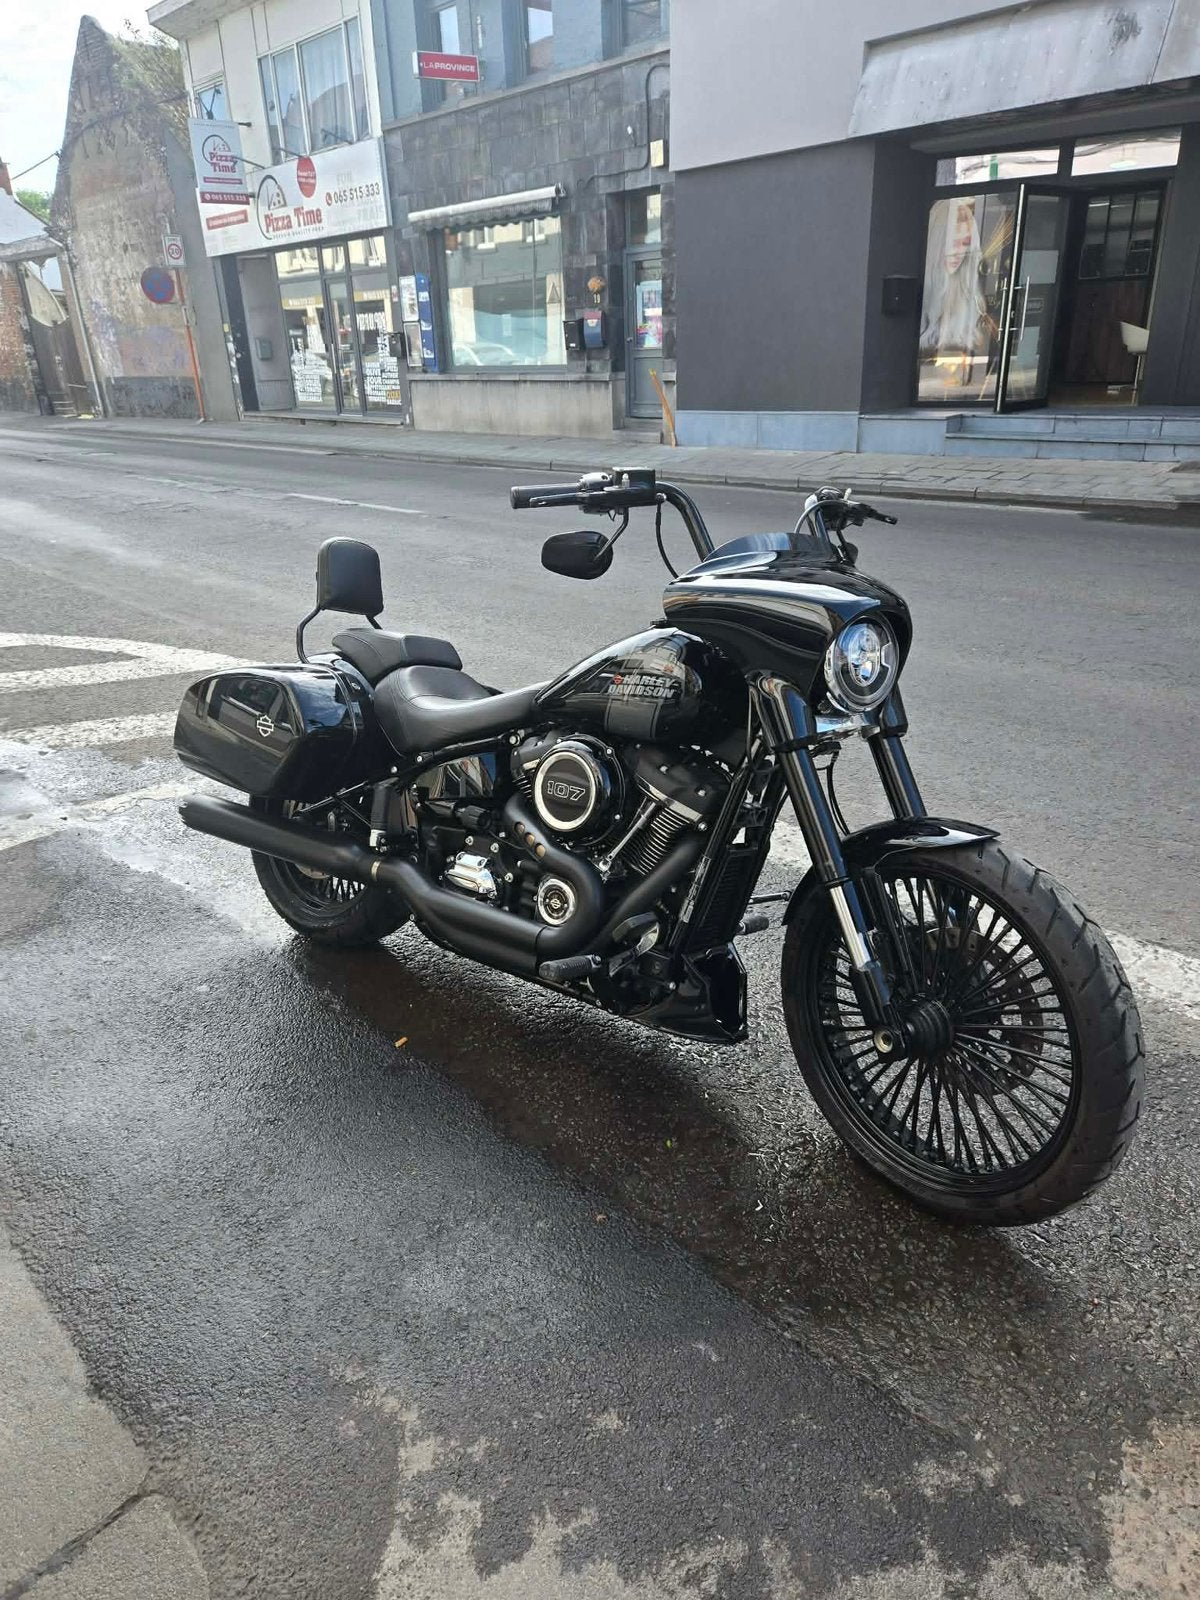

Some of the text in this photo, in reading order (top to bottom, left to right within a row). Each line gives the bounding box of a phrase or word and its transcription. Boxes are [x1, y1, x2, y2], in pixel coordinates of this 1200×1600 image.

[209, 151, 237, 163] Pizza
[211, 162, 237, 173] Time
[334, 182, 380, 204] 065 515 333
[264, 212, 293, 234] Pizza
[293, 205, 323, 228] Time
[607, 684, 676, 698] DAVIDSON
[547, 780, 585, 801] 107
